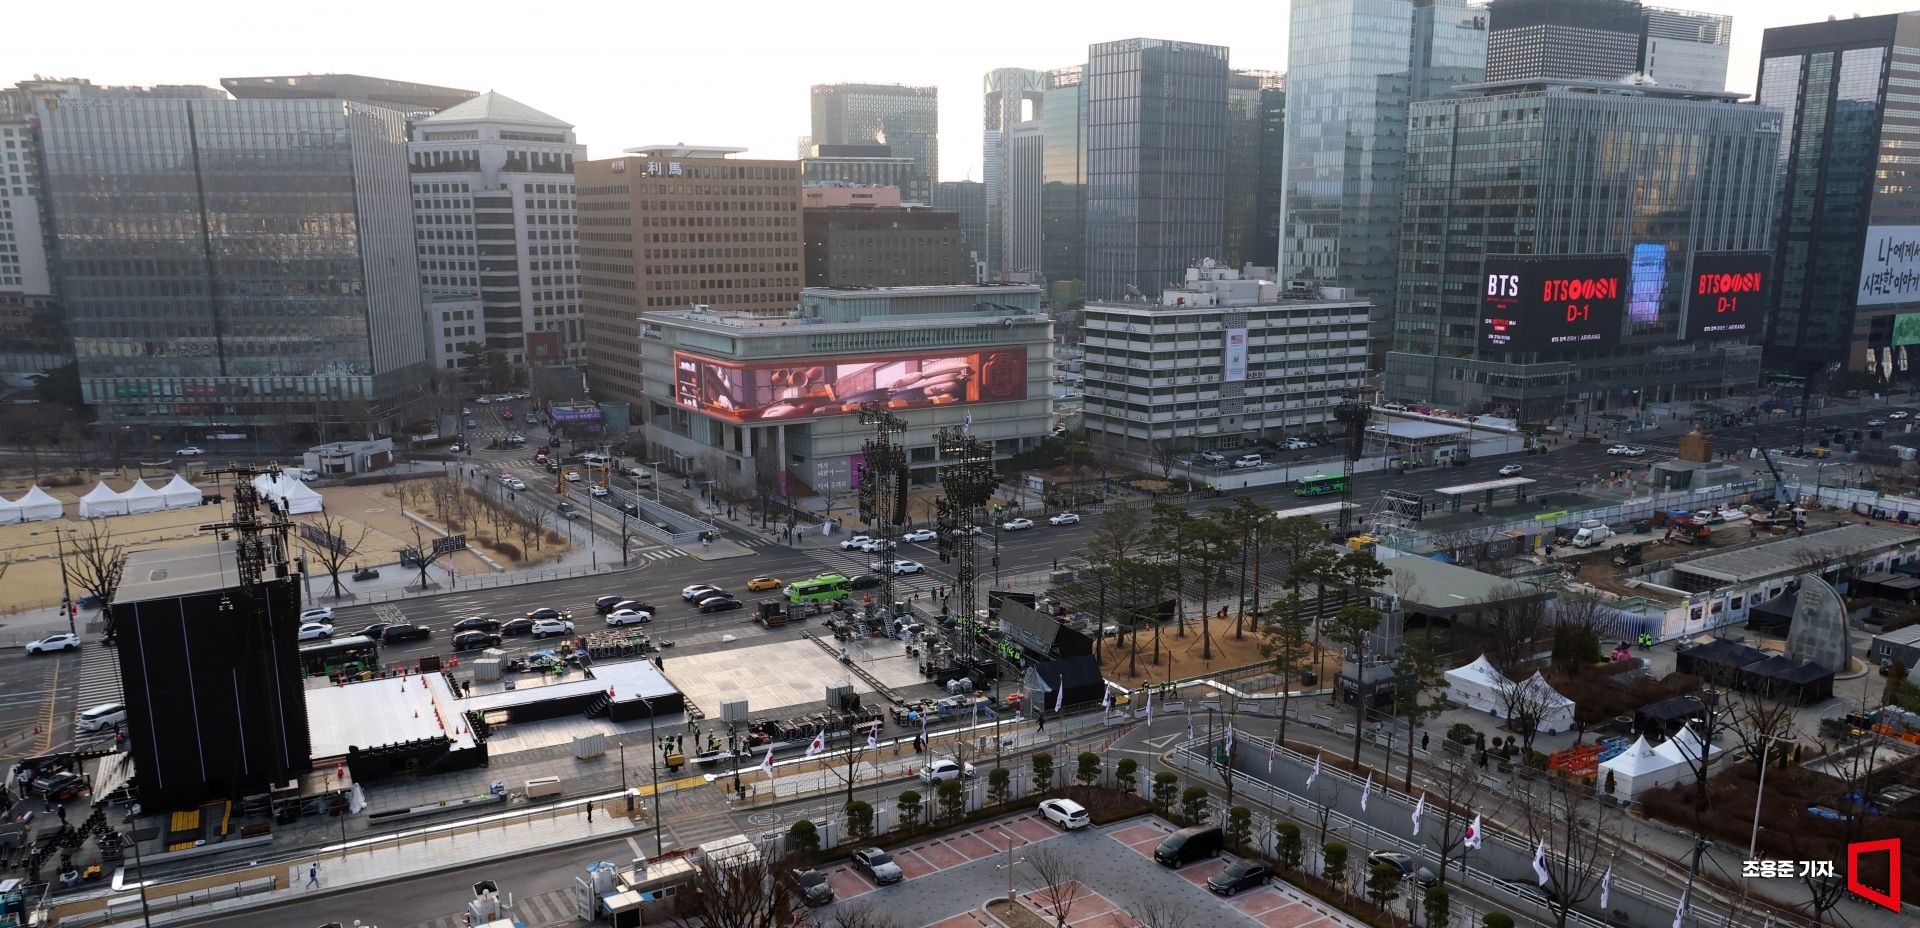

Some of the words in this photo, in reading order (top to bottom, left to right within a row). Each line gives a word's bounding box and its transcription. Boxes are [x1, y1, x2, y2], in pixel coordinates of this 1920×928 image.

[647, 161, 683, 176] 利馬
[1488, 275, 1519, 296] BTS
[1863, 268, 1894, 296] 시작한
[1894, 269, 1920, 294] 이야기
[1567, 304, 1589, 322] D-1
[1717, 296, 1737, 313] D-1
